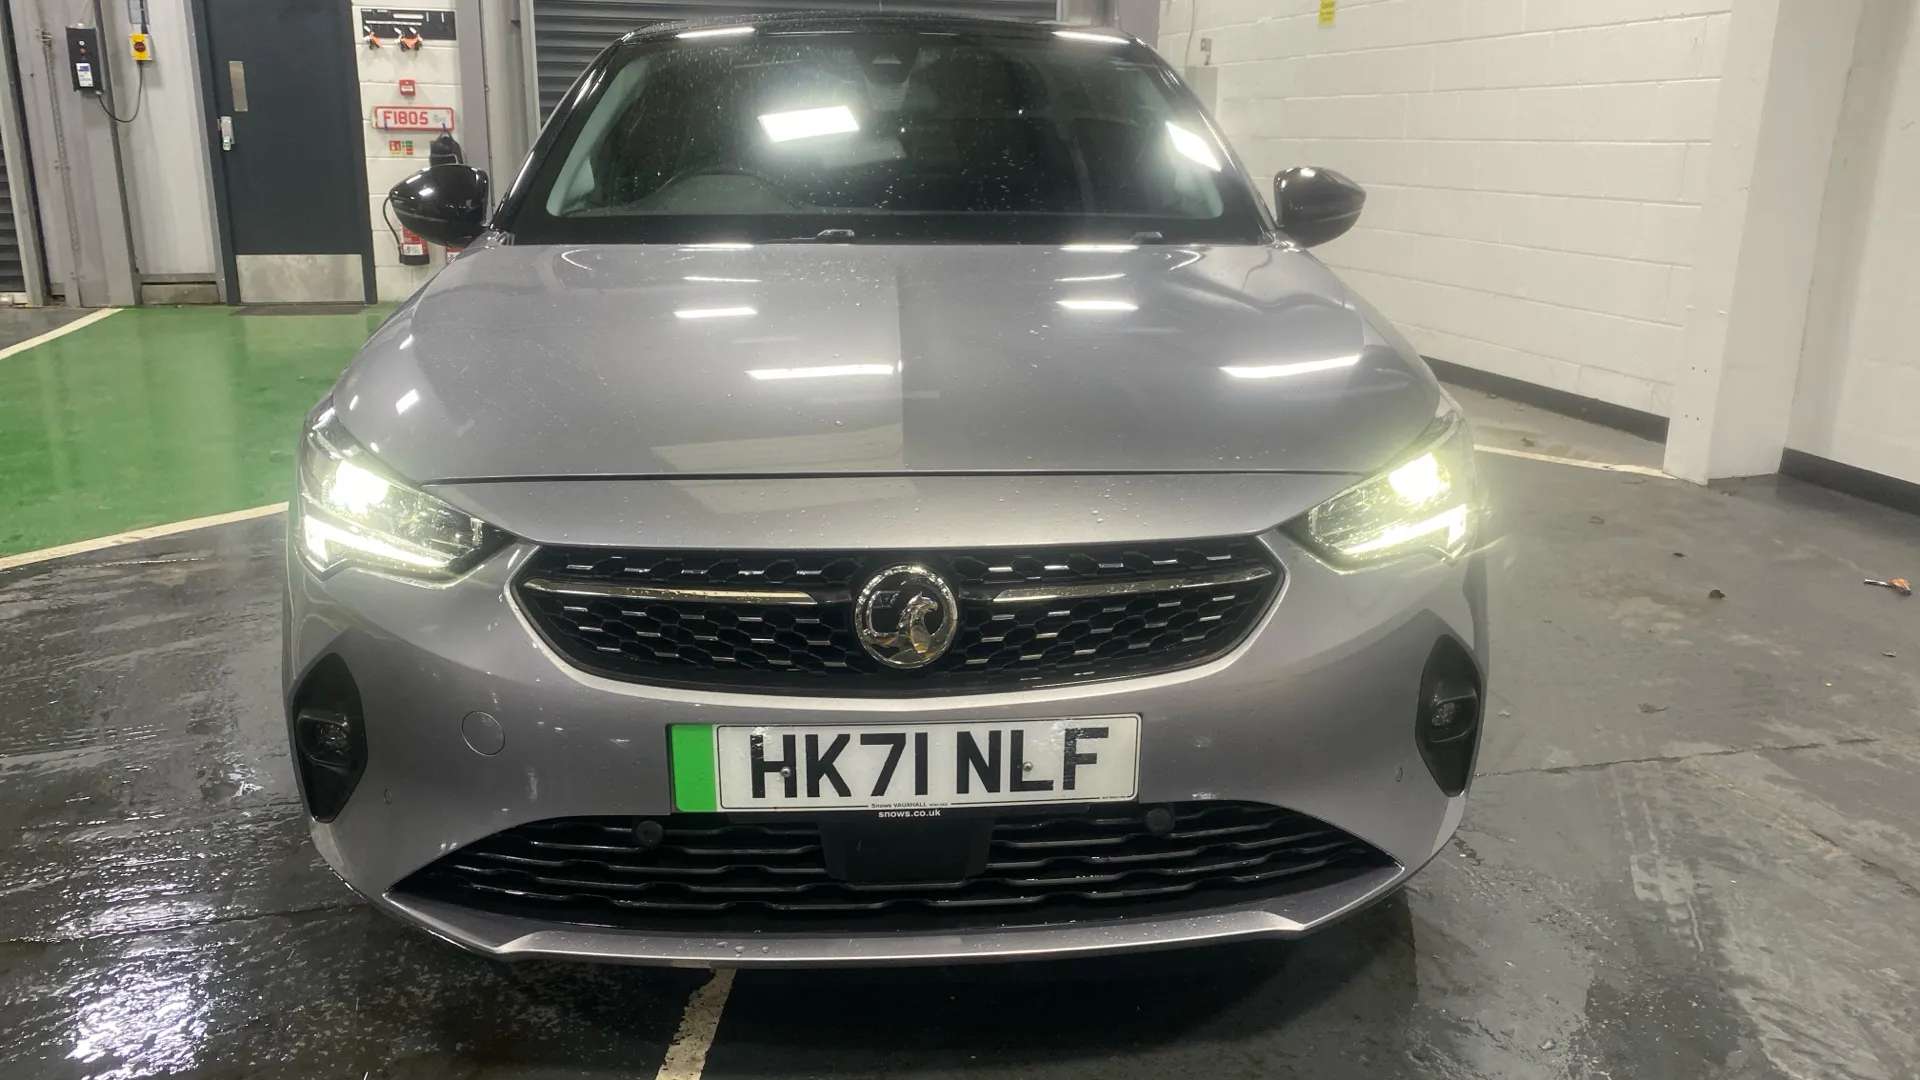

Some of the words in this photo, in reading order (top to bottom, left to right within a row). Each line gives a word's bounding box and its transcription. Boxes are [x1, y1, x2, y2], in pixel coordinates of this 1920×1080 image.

[750, 732, 929, 798] HK71
[956, 727, 1109, 794] NLF
[878, 809, 941, 818] snows.co.uk
